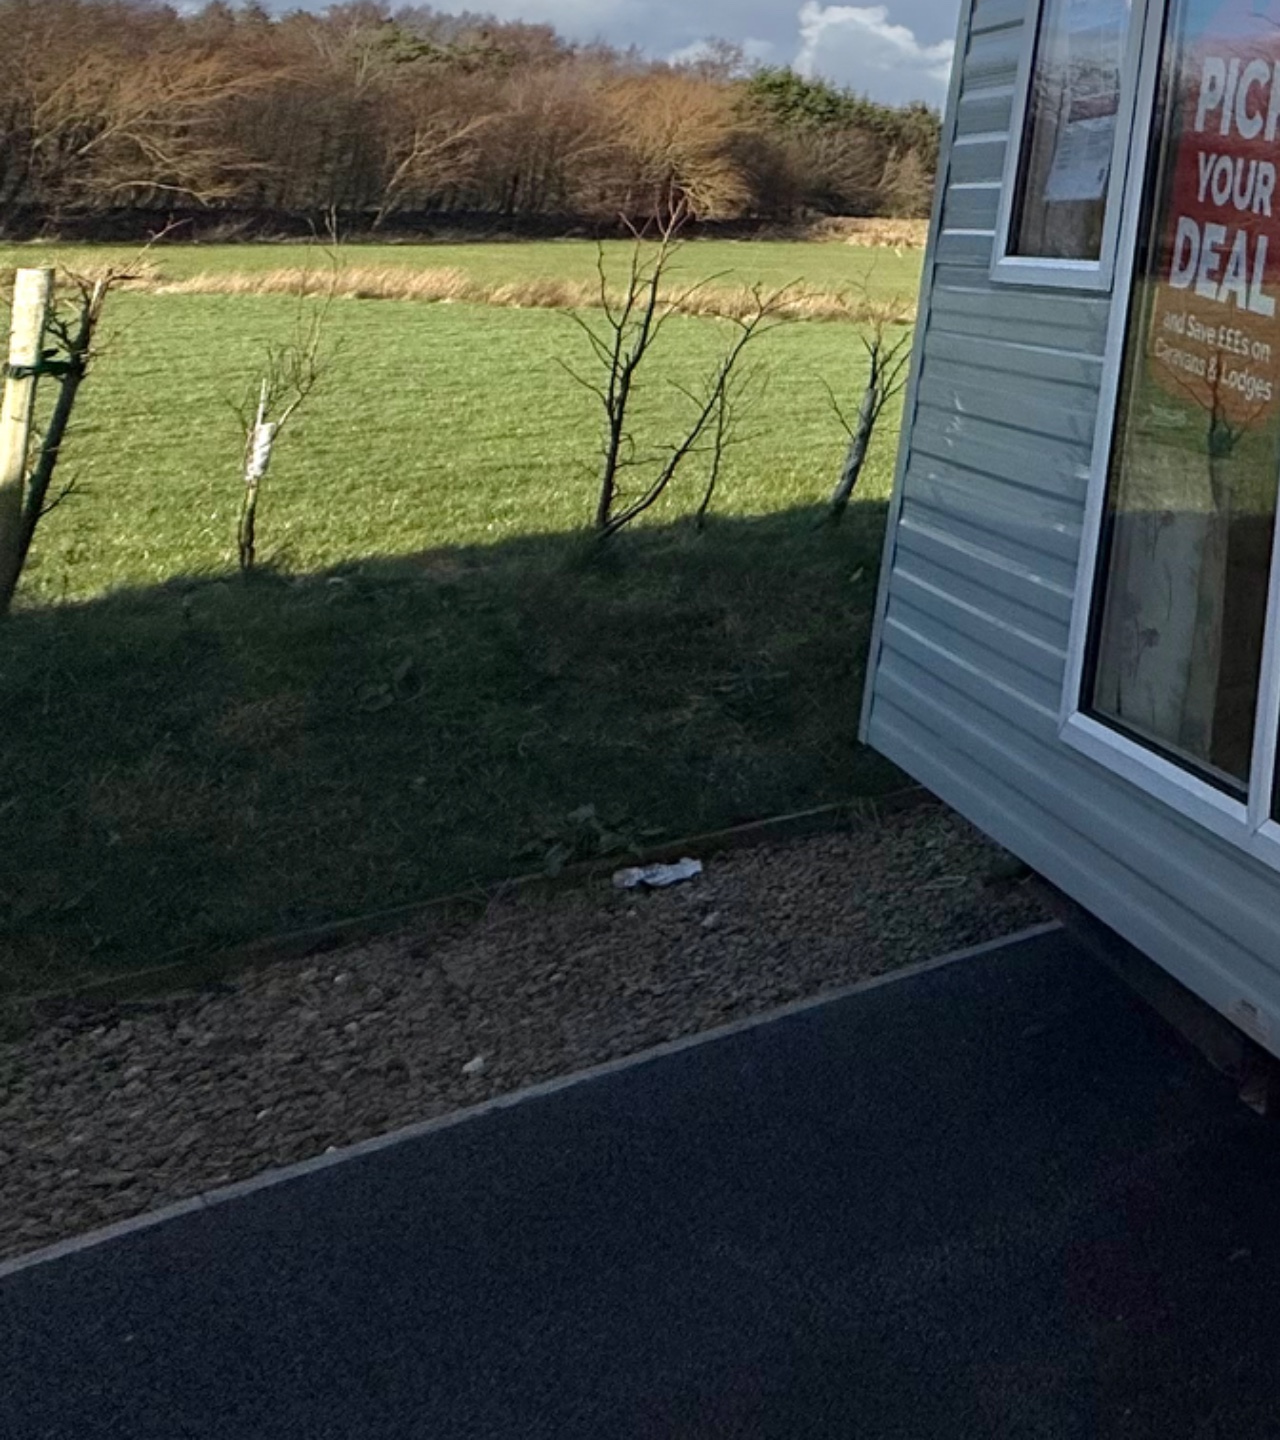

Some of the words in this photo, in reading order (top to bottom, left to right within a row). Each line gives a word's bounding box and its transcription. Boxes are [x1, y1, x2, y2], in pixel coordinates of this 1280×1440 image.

[1197, 151, 1276, 218] YOUR
[1169, 216, 1277, 318] DEAL
[1163, 310, 1187, 335] and
[1186, 313, 1216, 345] Save
[1251, 340, 1272, 364] on
[1207, 354, 1217, 383] &
[1219, 361, 1273, 401] Lodges
